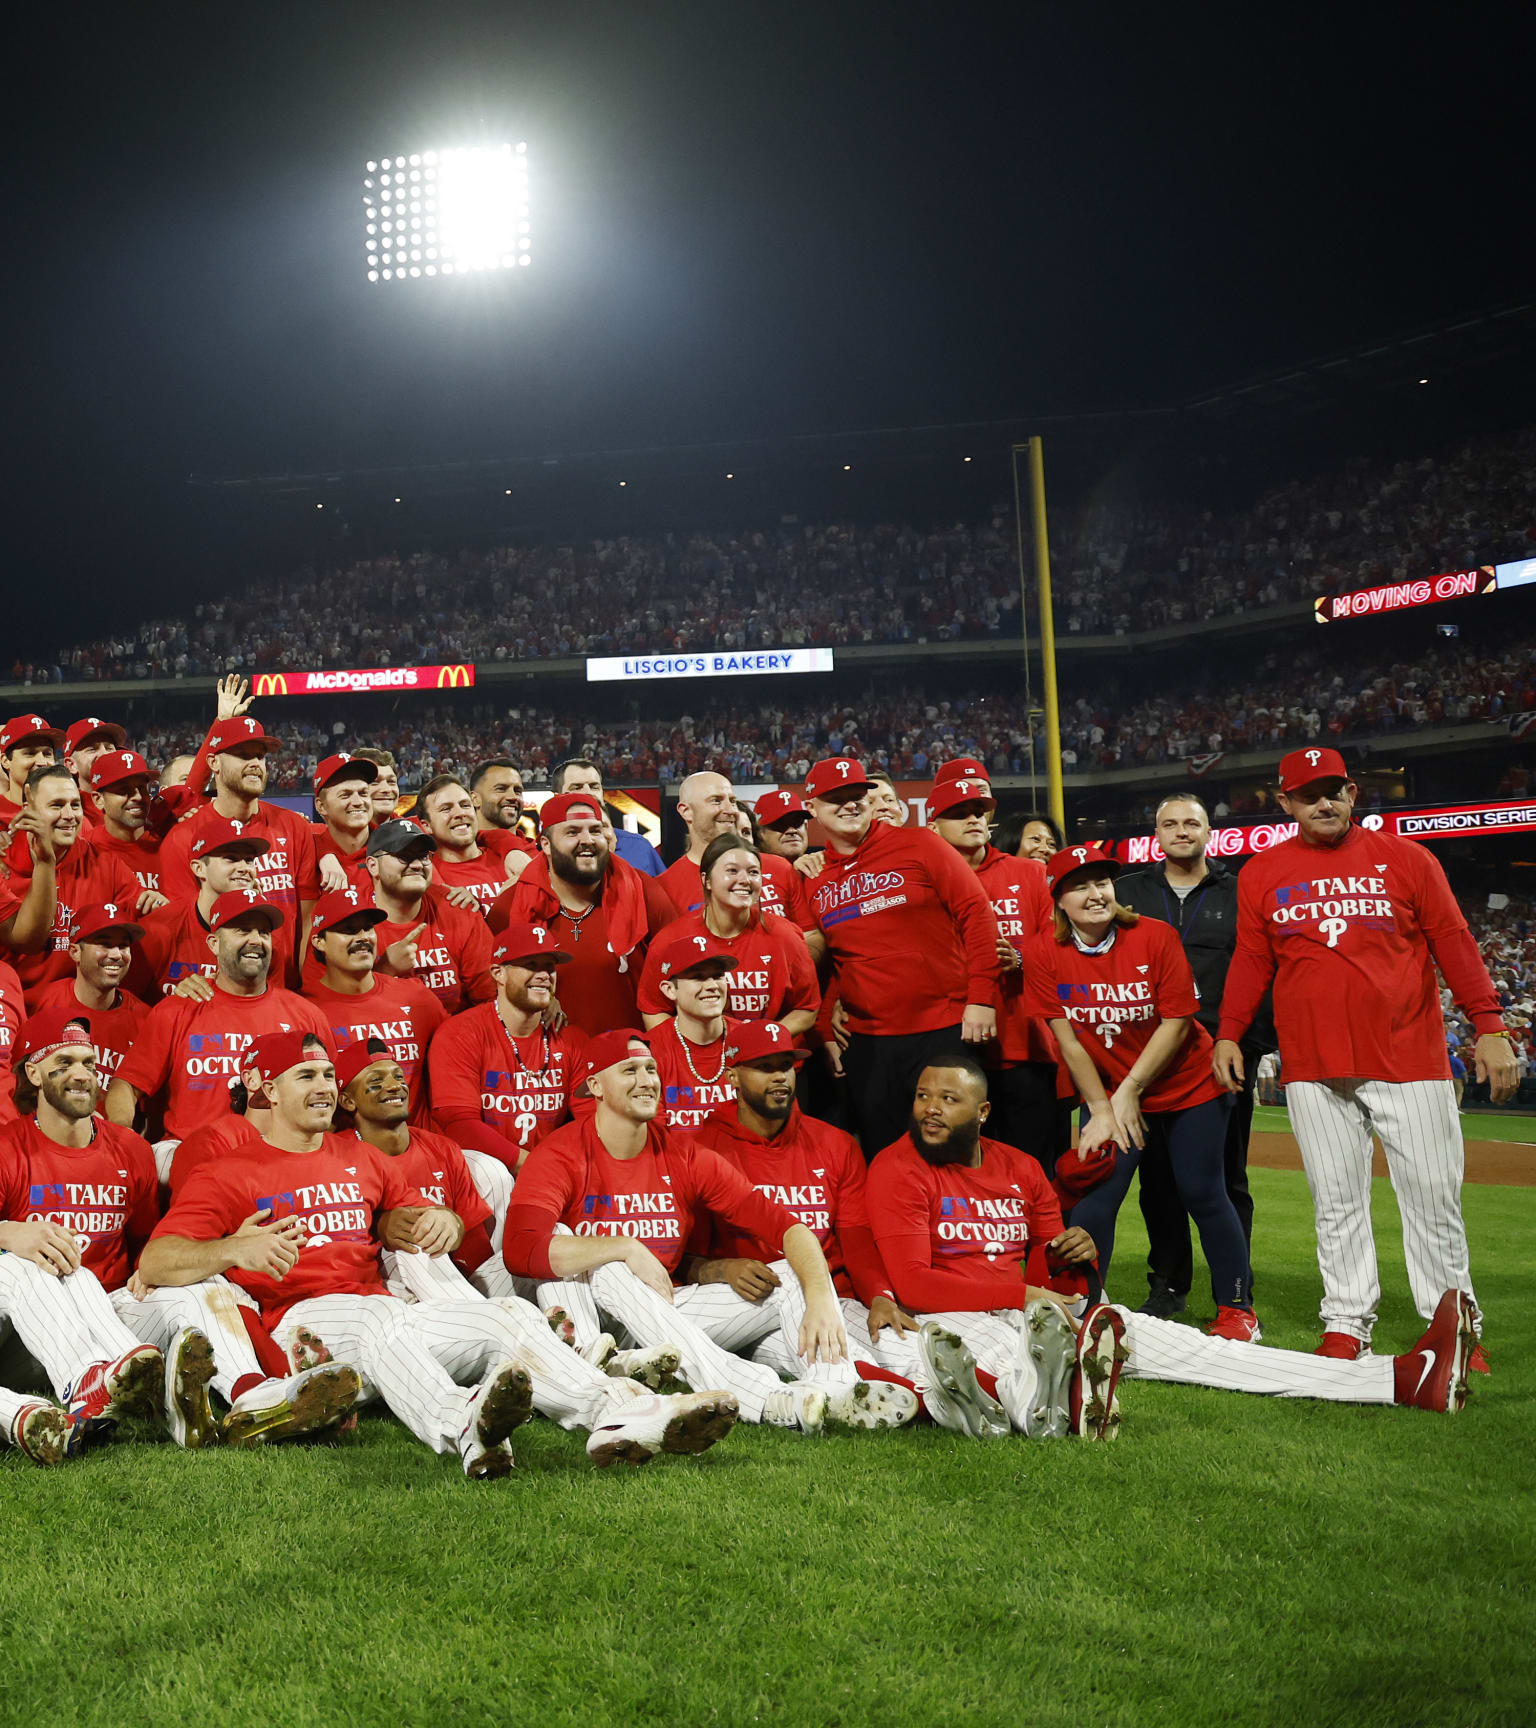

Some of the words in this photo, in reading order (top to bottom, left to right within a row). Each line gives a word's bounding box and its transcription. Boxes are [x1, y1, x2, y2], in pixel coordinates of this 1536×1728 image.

[1333, 579, 1431, 618] MOVING
[1434, 570, 1478, 598] ON
[624, 657, 706, 675] LISCIO'S
[713, 653, 792, 671] BAKERY
[307, 667, 418, 689] McDonald's
[1406, 813, 1480, 832] DIVISION
[1483, 808, 1536, 826] SERIE
[253, 851, 288, 872] AKE
[813, 871, 905, 914] Phillies
[1311, 876, 1387, 897] TAKE
[989, 898, 1020, 916] KE
[1272, 898, 1394, 924] OCTOBER
[1318, 917, 1348, 949] P
[724, 970, 769, 990] AKE
[1091, 980, 1151, 1003] TAKE
[1062, 1004, 1154, 1025] CTOBER
[350, 1020, 415, 1041] TAKE
[1095, 1023, 1122, 1050] P
[225, 1032, 254, 1052] TA
[513, 1067, 563, 1090] TAKE
[480, 1091, 564, 1112] OCTOBER
[694, 1084, 738, 1104] TAK
[514, 1112, 537, 1147] P
[65, 1183, 128, 1206] TAKE
[295, 1182, 365, 1209] TAKE
[613, 1192, 676, 1214] TAKE
[969, 1197, 1026, 1220] TAKE
[25, 1211, 127, 1233] CTOBER
[295, 1208, 367, 1235] OBER
[574, 1219, 681, 1239] OCTOBER
[937, 1221, 1029, 1242] OCTOBER
